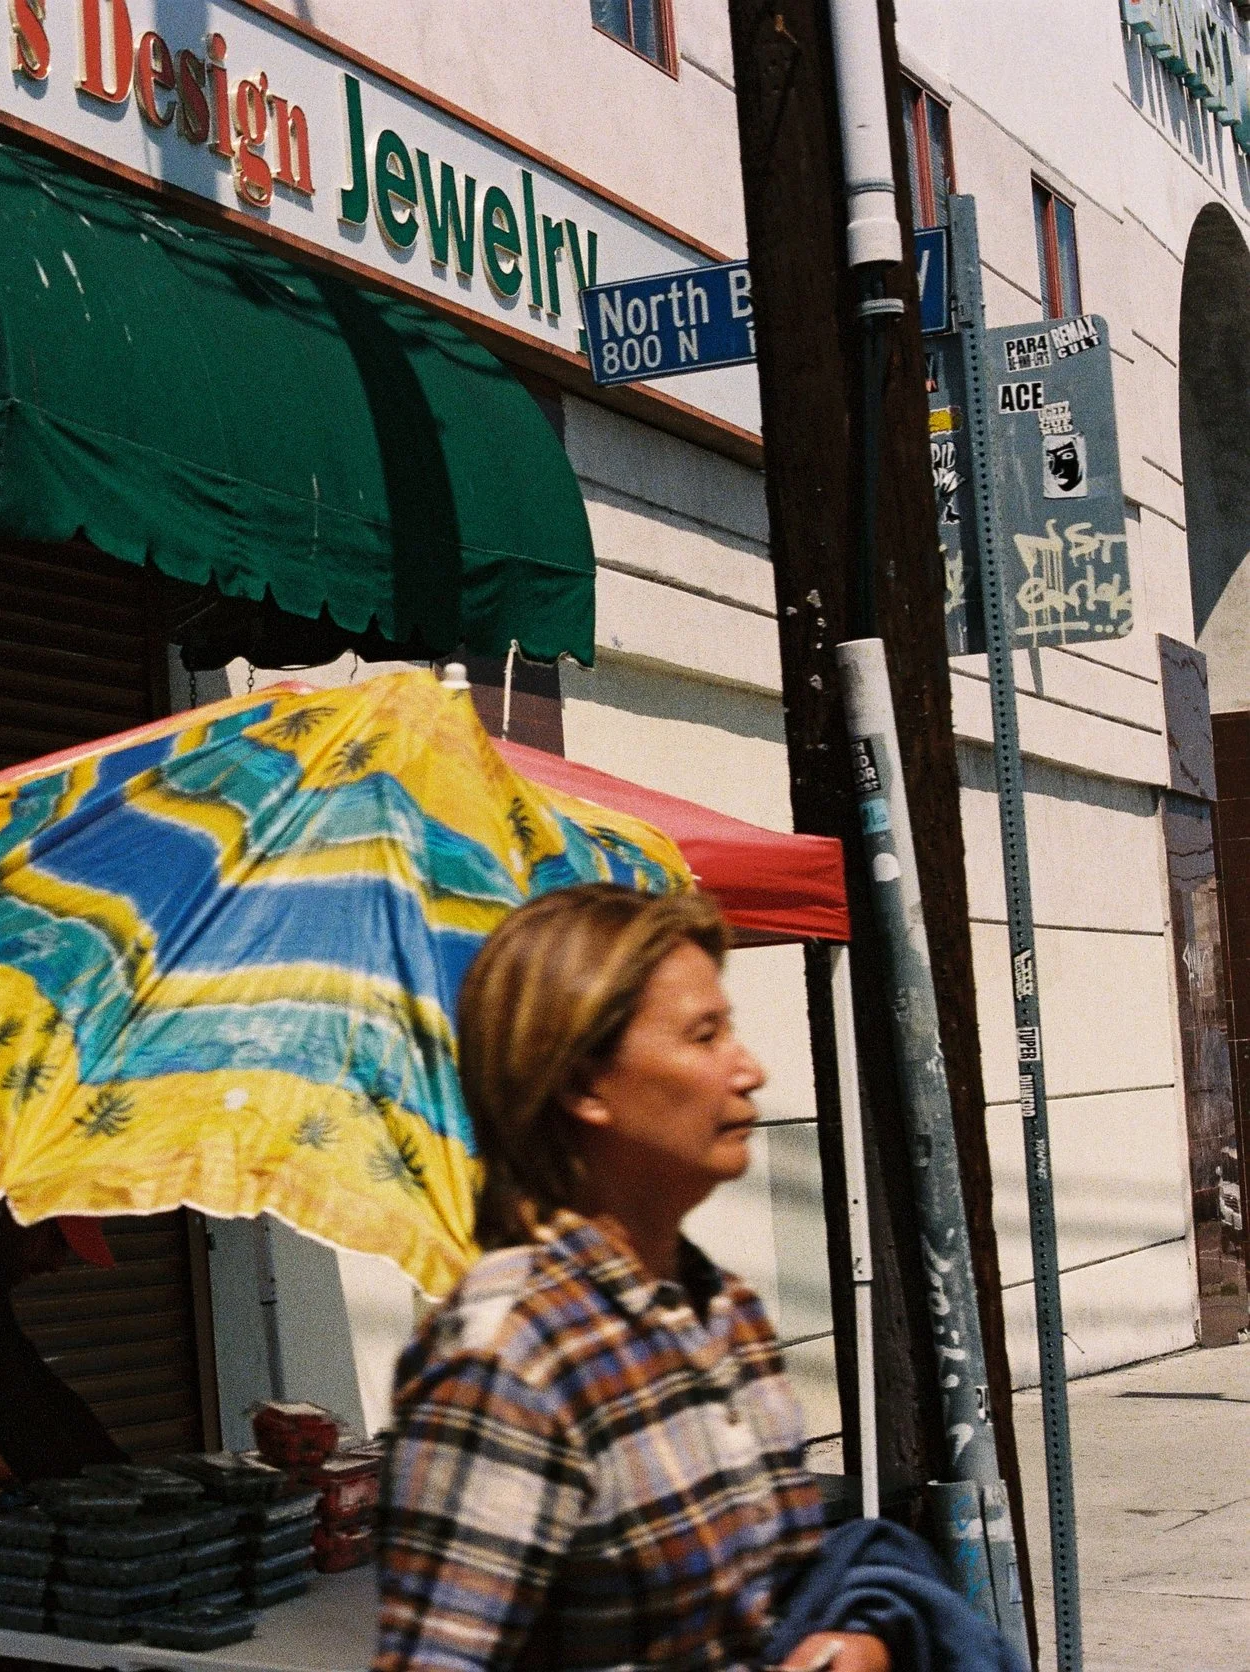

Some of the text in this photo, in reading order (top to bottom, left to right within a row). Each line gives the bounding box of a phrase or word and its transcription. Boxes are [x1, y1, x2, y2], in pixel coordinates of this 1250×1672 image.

[74, 0, 316, 207] Design
[337, 73, 599, 356] Jewelry
[597, 278, 711, 341] North
[602, 328, 699, 375] 800 N
[1050, 315, 1098, 349] REMAX
[1057, 335, 1101, 359] CULT
[1000, 382, 1043, 412] ACE
[1018, 1029, 1038, 1060] TUPER
